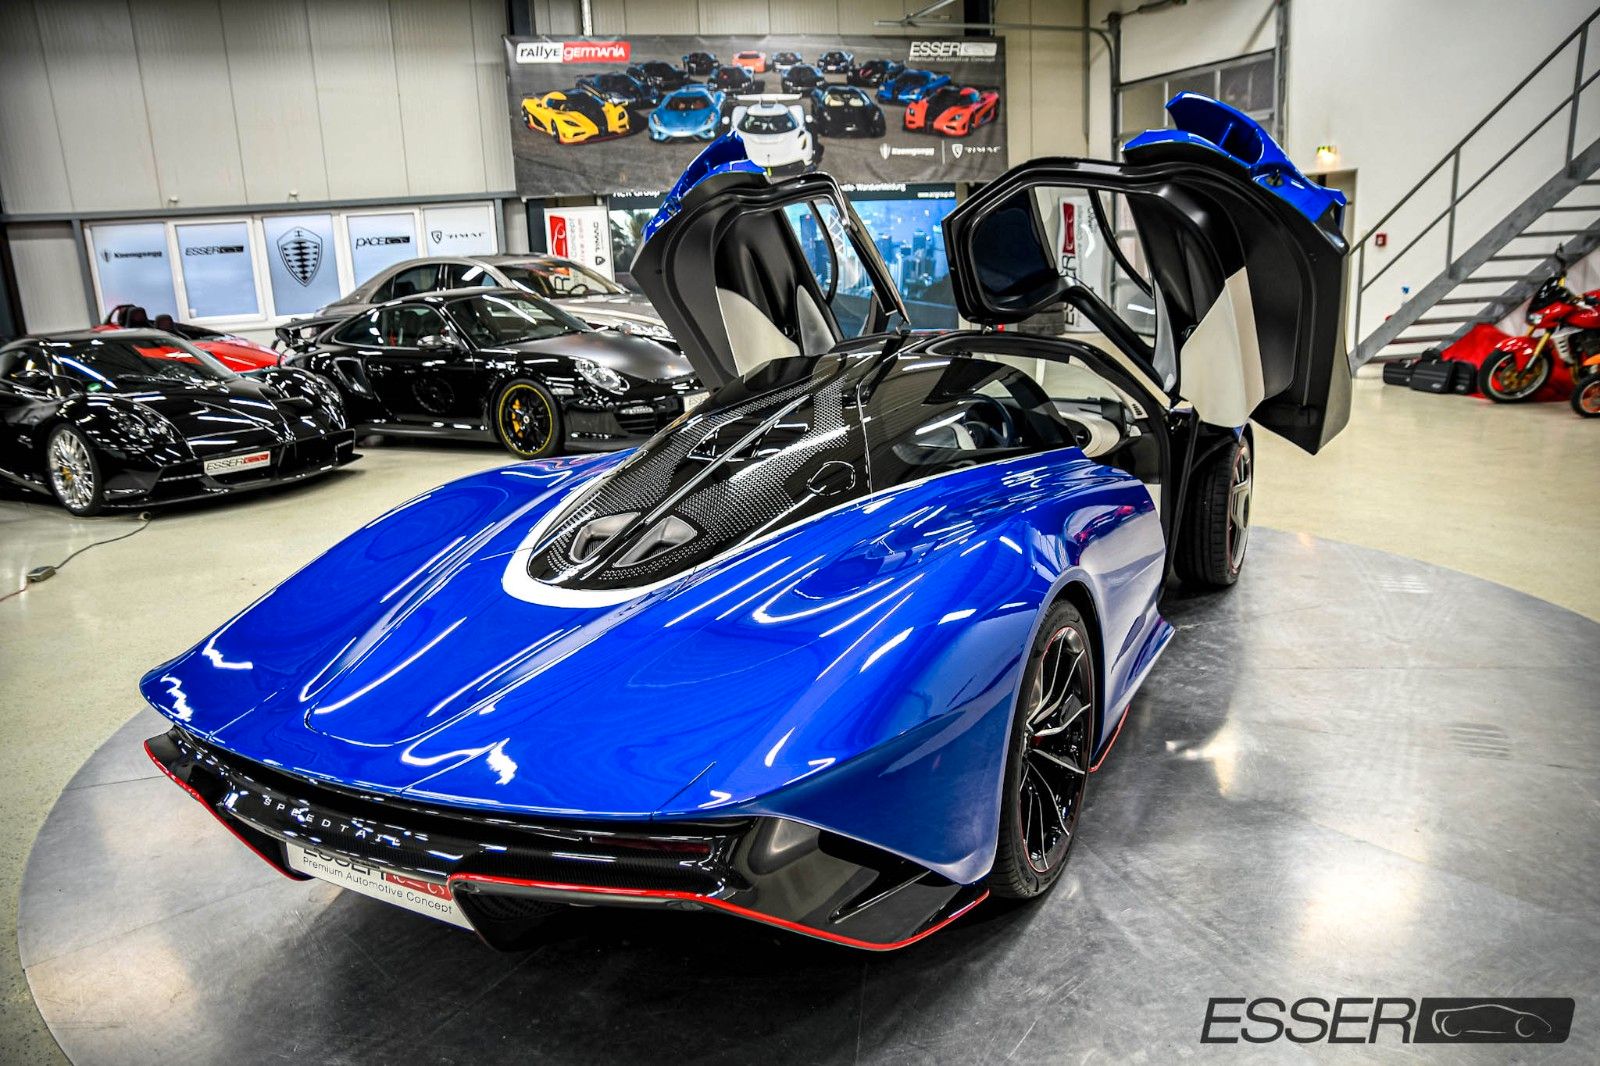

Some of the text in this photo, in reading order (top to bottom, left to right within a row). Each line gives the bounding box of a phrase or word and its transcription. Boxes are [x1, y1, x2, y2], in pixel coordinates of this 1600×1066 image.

[909, 42, 961, 56] ESSER
[206, 457, 244, 471] ESSER
[303, 856, 343, 885] Premium
[345, 872, 404, 898] Automotive
[406, 891, 453, 914] Concept
